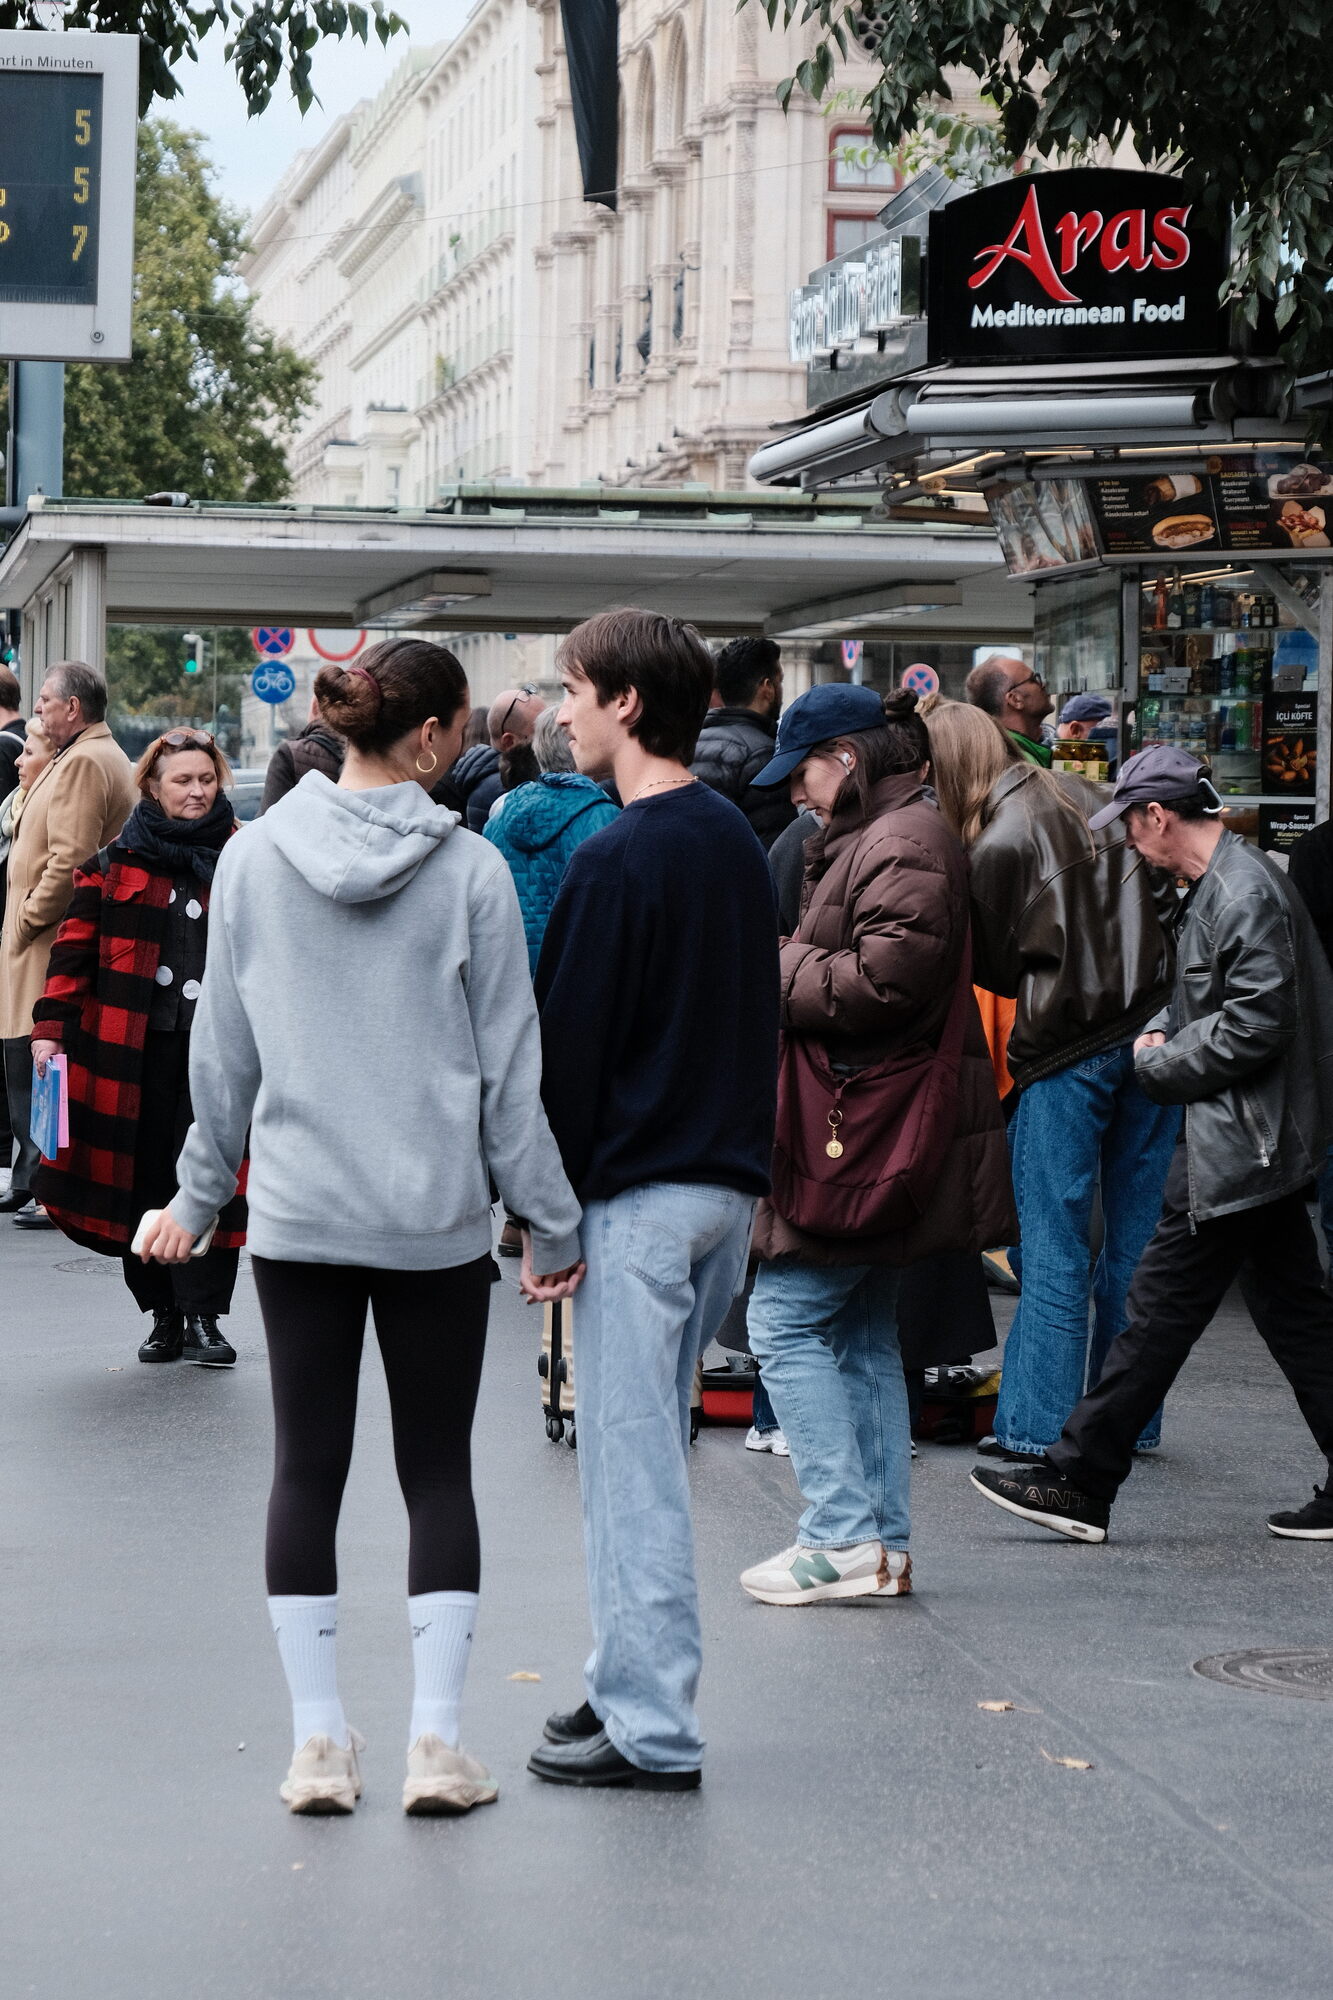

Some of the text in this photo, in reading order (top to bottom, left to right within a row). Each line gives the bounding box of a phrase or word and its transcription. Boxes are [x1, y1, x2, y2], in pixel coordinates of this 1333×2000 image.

[21, 55, 33, 66] in
[37, 56, 93, 69] Minuten
[75, 109, 91, 146] 5
[73, 167, 90, 204] 5
[72, 225, 88, 262] 7
[968, 183, 1193, 302] Aras
[971, 296, 1186, 329] Mediterranean Food
[789, 1553, 841, 1590] N
